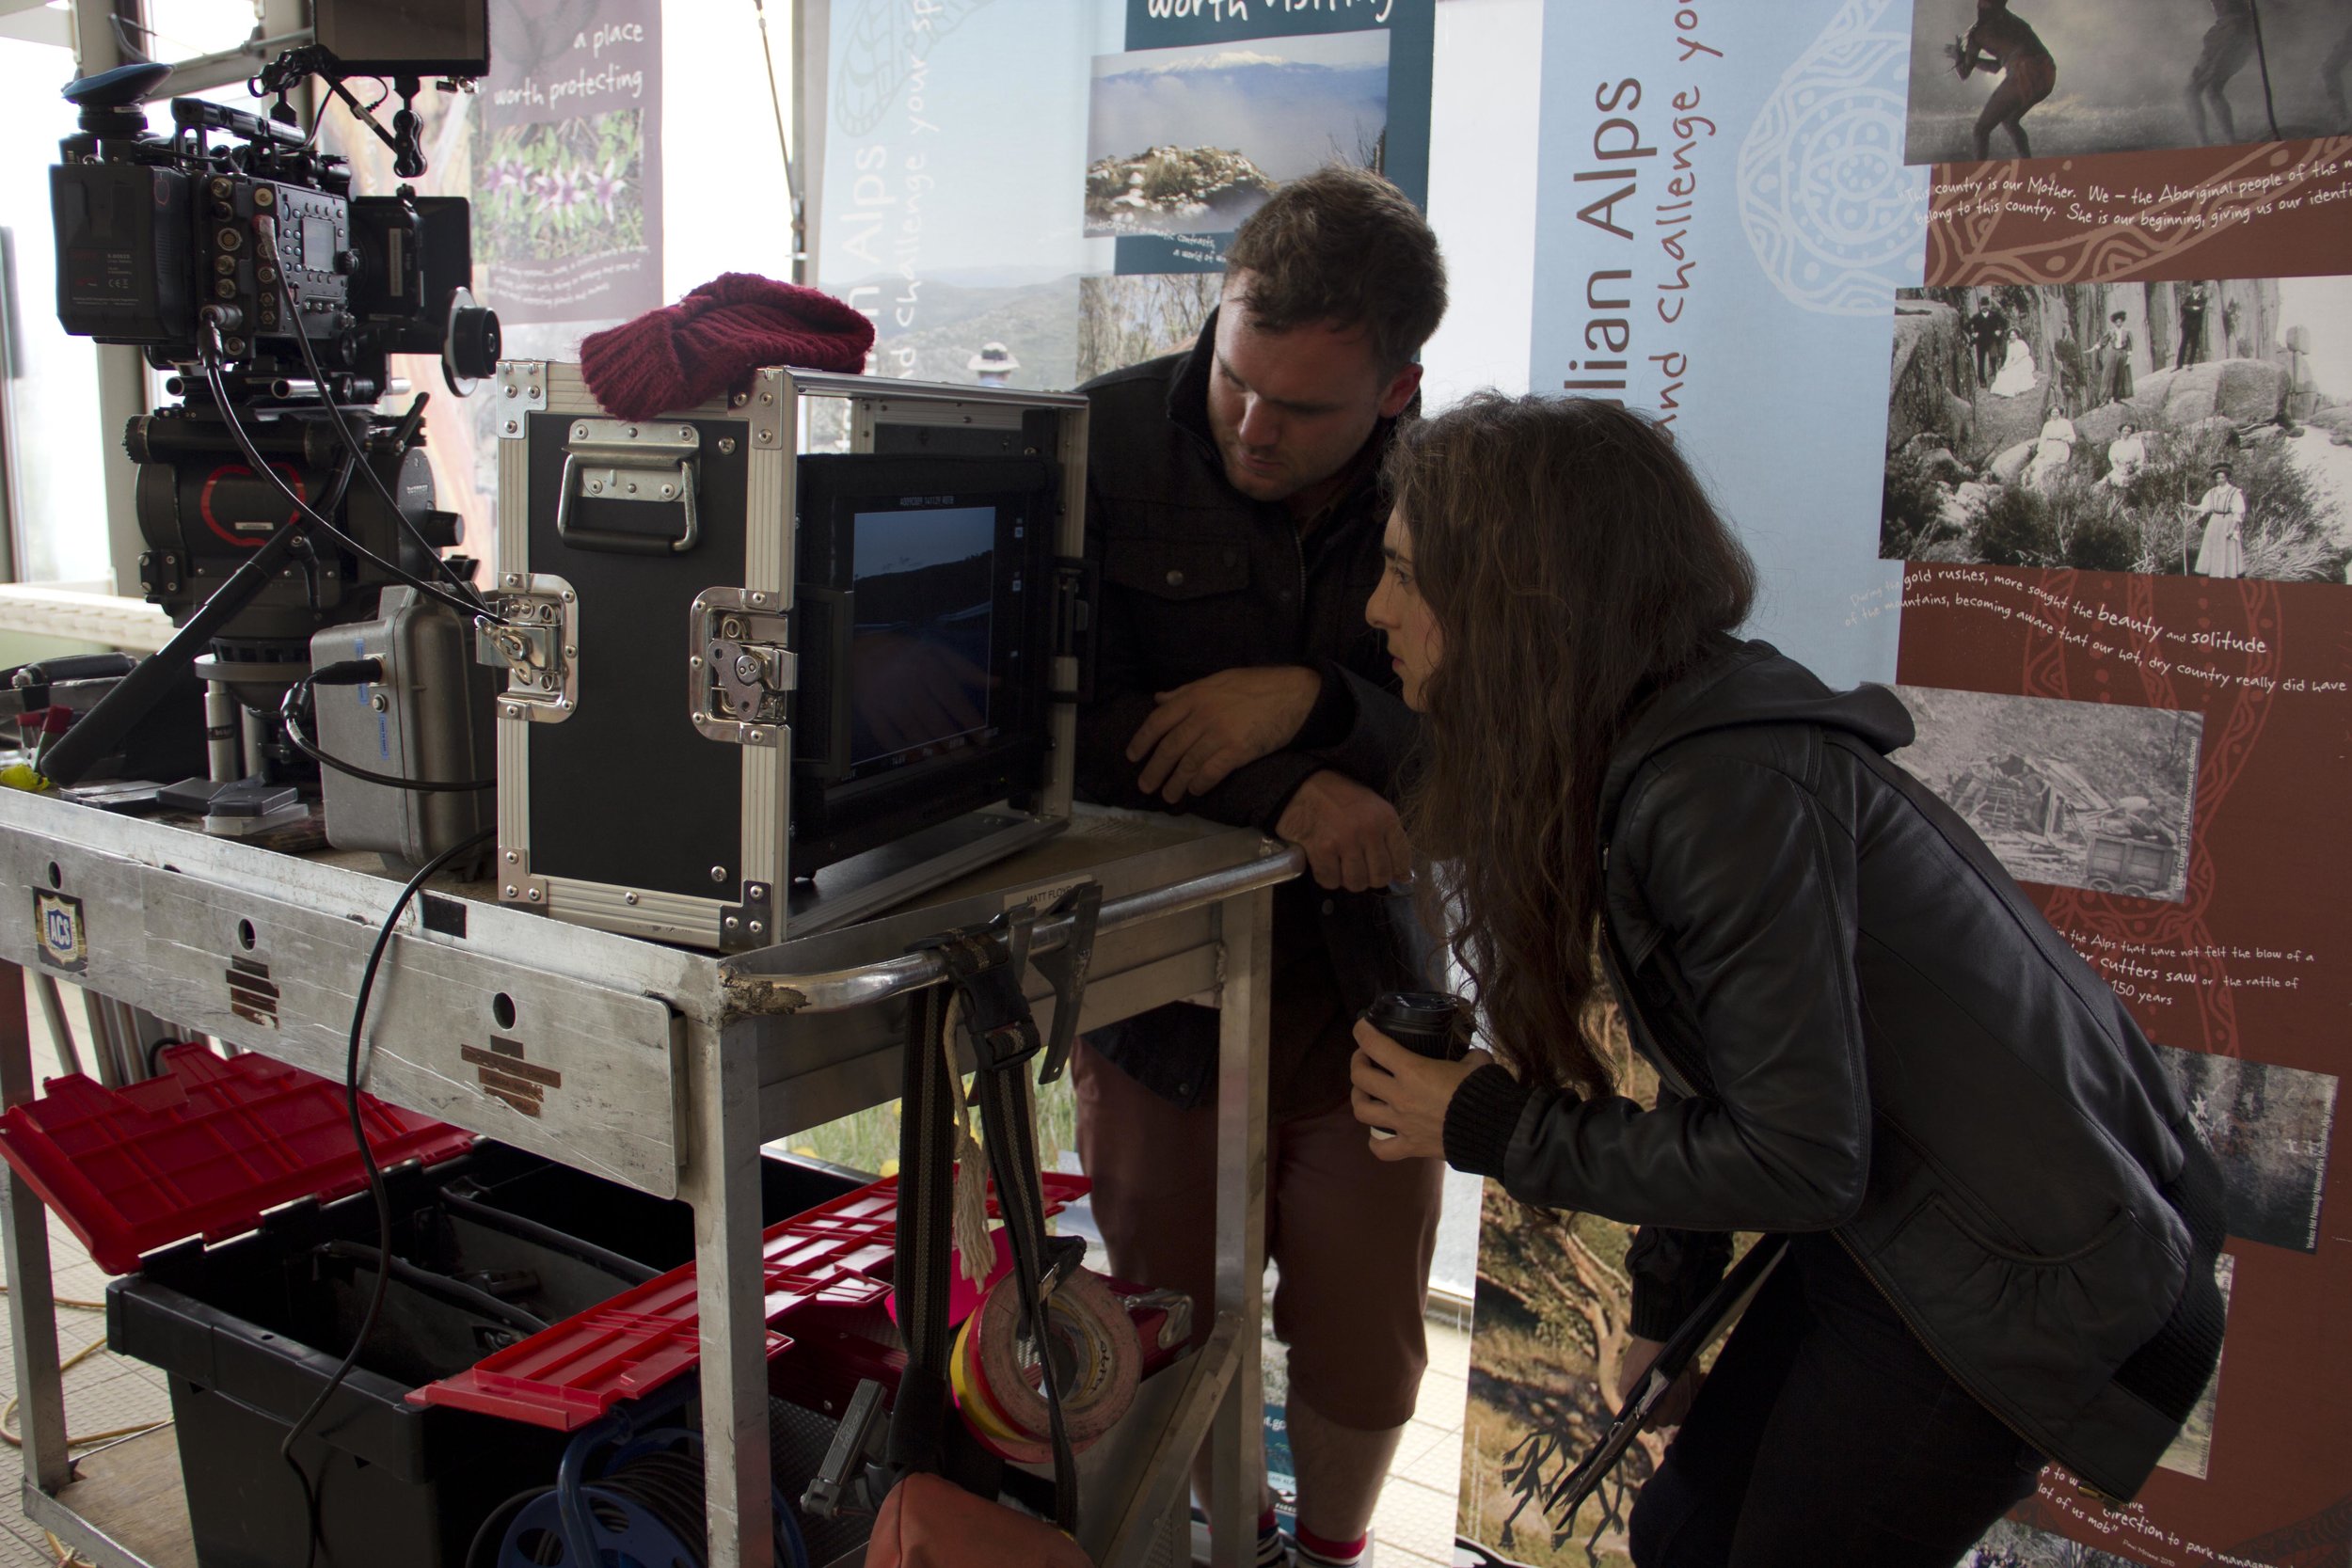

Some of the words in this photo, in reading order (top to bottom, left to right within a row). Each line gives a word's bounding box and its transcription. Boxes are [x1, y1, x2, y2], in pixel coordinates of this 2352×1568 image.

[593, 23, 644, 59] place
[1674, 0, 1724, 62] yo
[493, 76, 545, 106] worth
[548, 62, 644, 110] protecting
[908, 54, 940, 135] your
[1573, 77, 1658, 241] Alps
[1934, 176, 1982, 197] country
[1988, 176, 1998, 191] is
[2002, 181, 2024, 191] our
[2026, 176, 2076, 199] Mother.
[2089, 185, 2109, 203] We
[2131, 187, 2153, 204] the
[2158, 182, 2233, 205] Aboriginal
[2238, 172, 2281, 198] people
[2288, 163, 2306, 182] of
[2312, 160, 2338, 178] the
[840, 144, 898, 265] Alps
[1655, 85, 1716, 324] challenge
[1915, 207, 1952, 227] belong
[1957, 200, 1971, 216] to
[1976, 198, 1999, 214] this
[2005, 199, 2057, 223] country.
[2066, 201, 2093, 225] She
[2098, 210, 2108, 225] is
[2113, 214, 2135, 226] our
[2140, 210, 2206, 232] beginning,
[2211, 205, 2250, 230] giving
[2257, 201, 2273, 215] us
[2279, 196, 2302, 211] our
[1903, 569, 1932, 591] gold
[1938, 568, 1989, 586] rushes,
[1994, 575, 2023, 591] more
[2027, 584, 2069, 610] sought
[2073, 600, 2093, 619] the
[2097, 603, 2163, 643] beauty
[2166, 631, 2186, 642] and
[2190, 630, 2267, 654] solitude
[1884, 593, 1950, 610] mountains,
[1955, 592, 2011, 620] becoming
[2016, 610, 2054, 634] aware
[2058, 626, 2089, 647] that
[2092, 641, 2114, 655] our
[2119, 649, 2144, 667] hot,
[2148, 657, 2171, 676] dry
[2176, 664, 2231, 689] country
[2235, 675, 2278, 695] really
[2282, 677, 2305, 692] did
[2312, 680, 2348, 693] have
[1026, 892, 1047, 903] MATT
[50, 915, 72, 946] ACS
[2069, 929, 2087, 942] the
[2090, 933, 2117, 951] Alps
[2121, 941, 2146, 955] that
[2151, 946, 2176, 958] have
[2181, 946, 2200, 958] not
[2204, 945, 2227, 958] felt
[2232, 946, 2251, 958] the
[2255, 947, 2281, 958] blow
[2286, 950, 2302, 962] of
[2305, 954, 2315, 962] a
[2100, 958, 2159, 979] cutters
[2165, 972, 2198, 984] saw
[2222, 975, 2243, 987] the
[2246, 975, 2281, 988] rattle
[2284, 977, 2300, 990] of
[2110, 979, 2136, 996] 150
[2137, 991, 2173, 1005] years
[2054, 1466, 2065, 1481] to
[2038, 1482, 2055, 1499] lot
[2056, 1497, 2073, 1511] of
[2072, 1507, 2085, 1519] us
[2168, 1532, 2180, 1545] to
[2185, 1542, 2214, 1560] park
